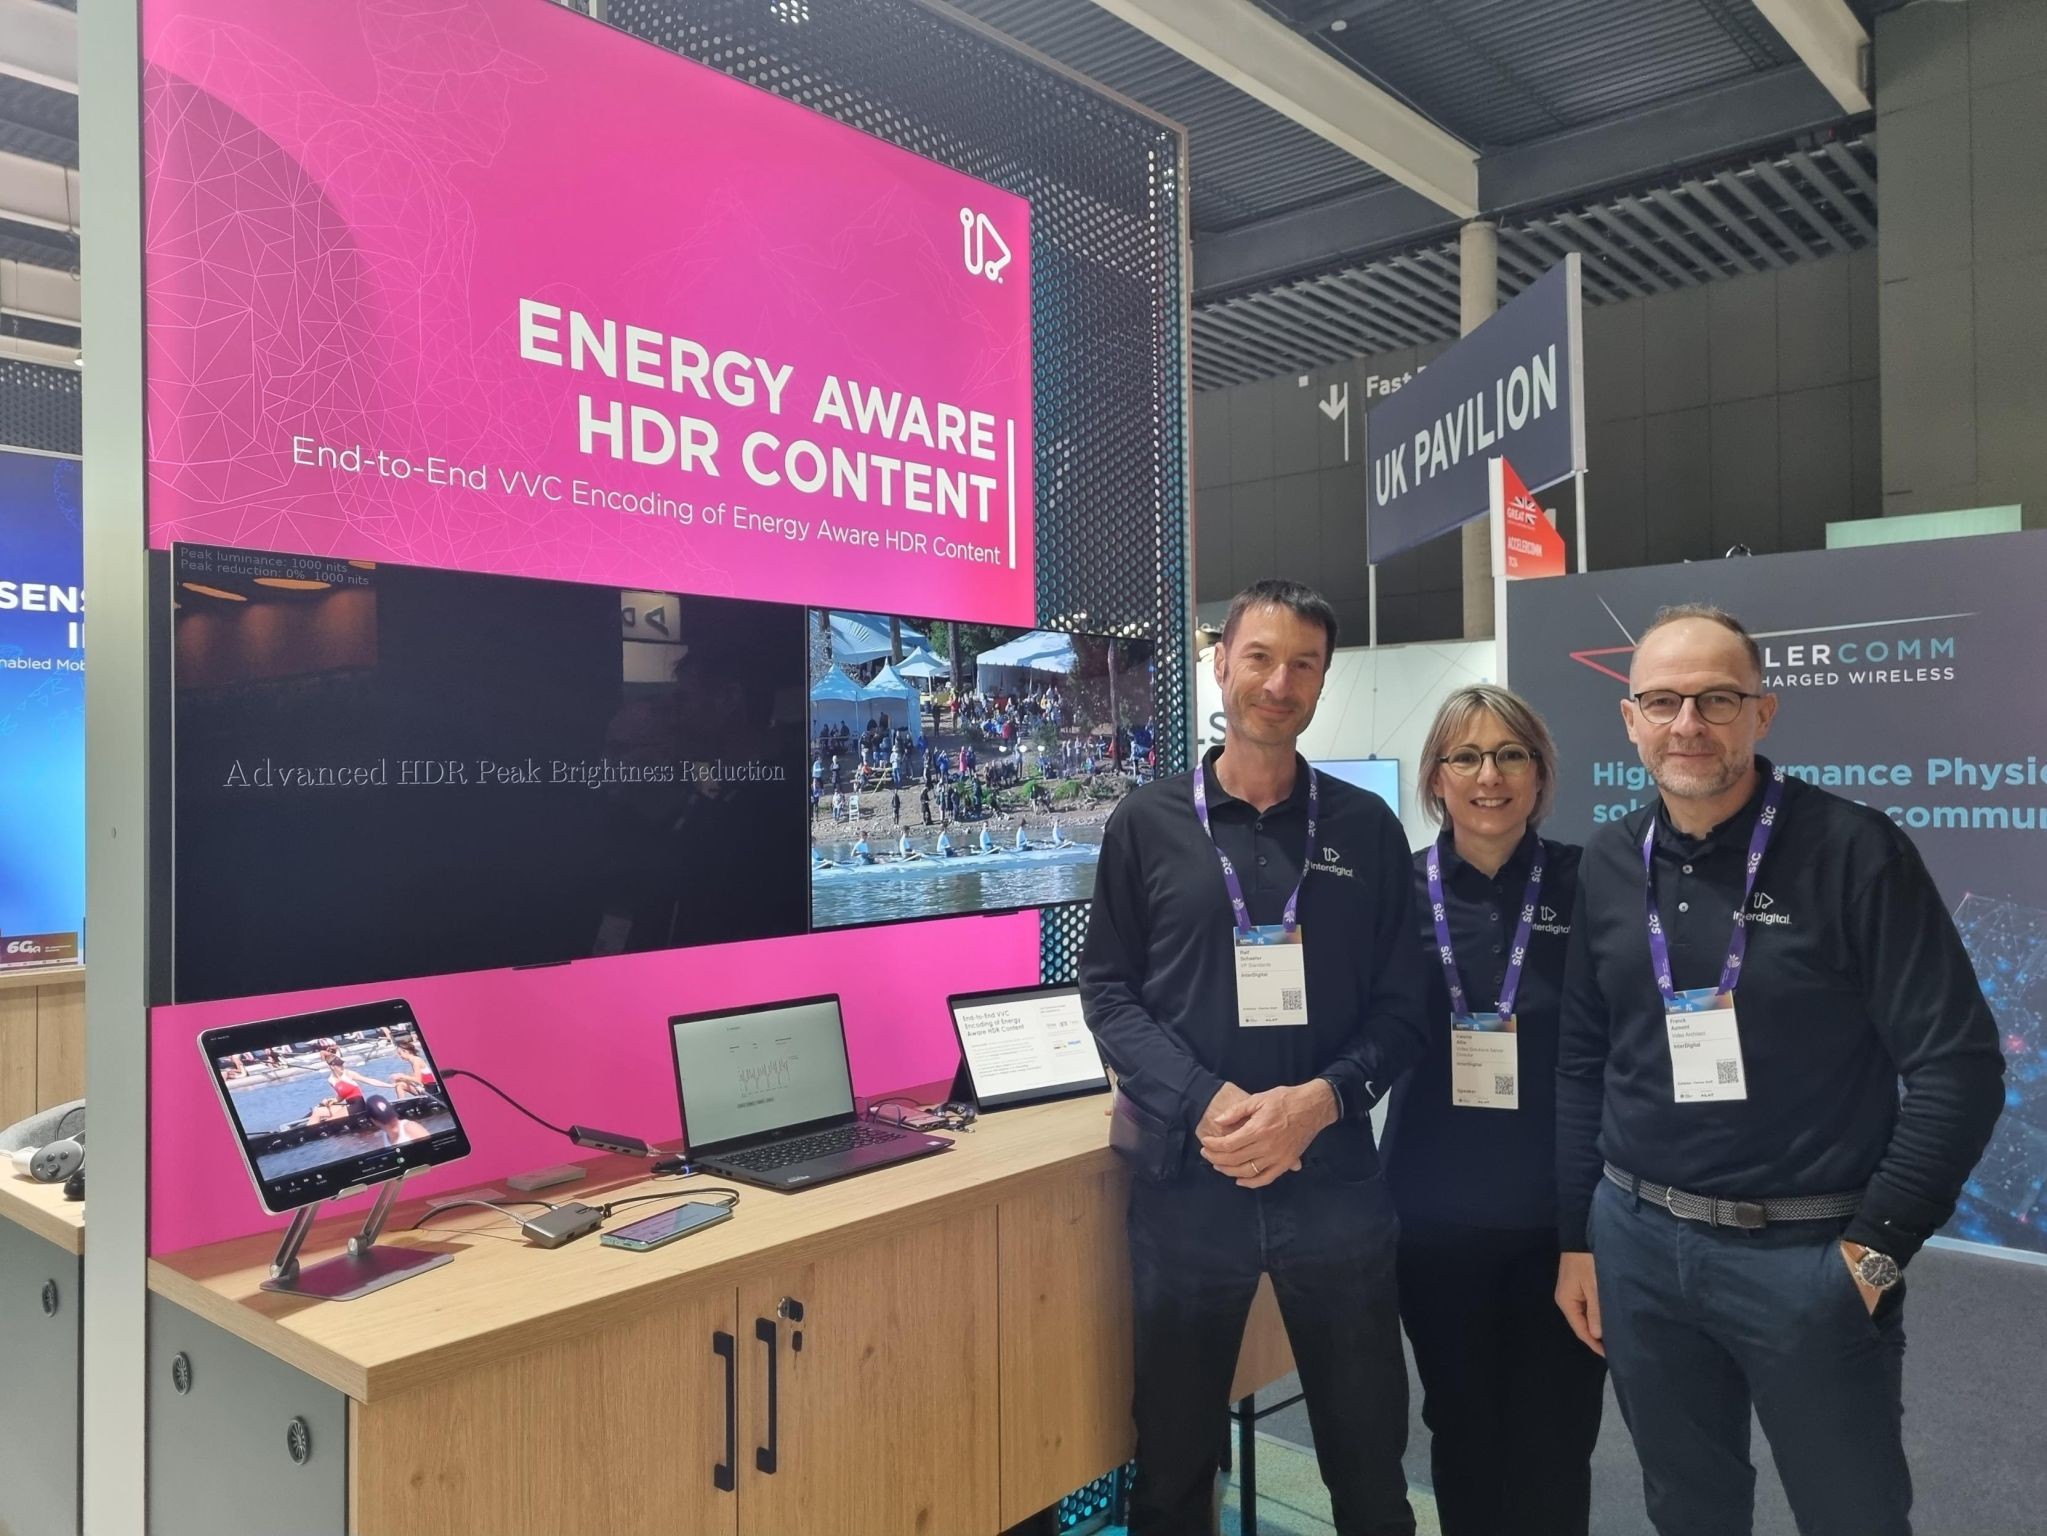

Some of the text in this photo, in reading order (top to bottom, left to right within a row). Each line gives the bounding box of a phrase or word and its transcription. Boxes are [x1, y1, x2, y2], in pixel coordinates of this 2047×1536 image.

[519, 298, 996, 461] ENERGY AWARE
[1375, 343, 1558, 506] UK PAVILION
[578, 395, 997, 523] HDR CONTENT
[293, 436, 1001, 566] End-to-End VVC Encoding of Energy Aware HDR Content
[180, 547, 348, 573] Peak luminance: 1000 nits
[180, 559, 369, 585] Peak reduction: 0% 1000 nits
[0, 581, 84, 613] SEN
[1765, 637, 1955, 668] LERCOMM
[1762, 667, 1954, 687] HARGED WIRELESS
[222, 757, 786, 789] Advanced HDR Peak Brightness Reduction
[1593, 761, 1654, 791] Hig
